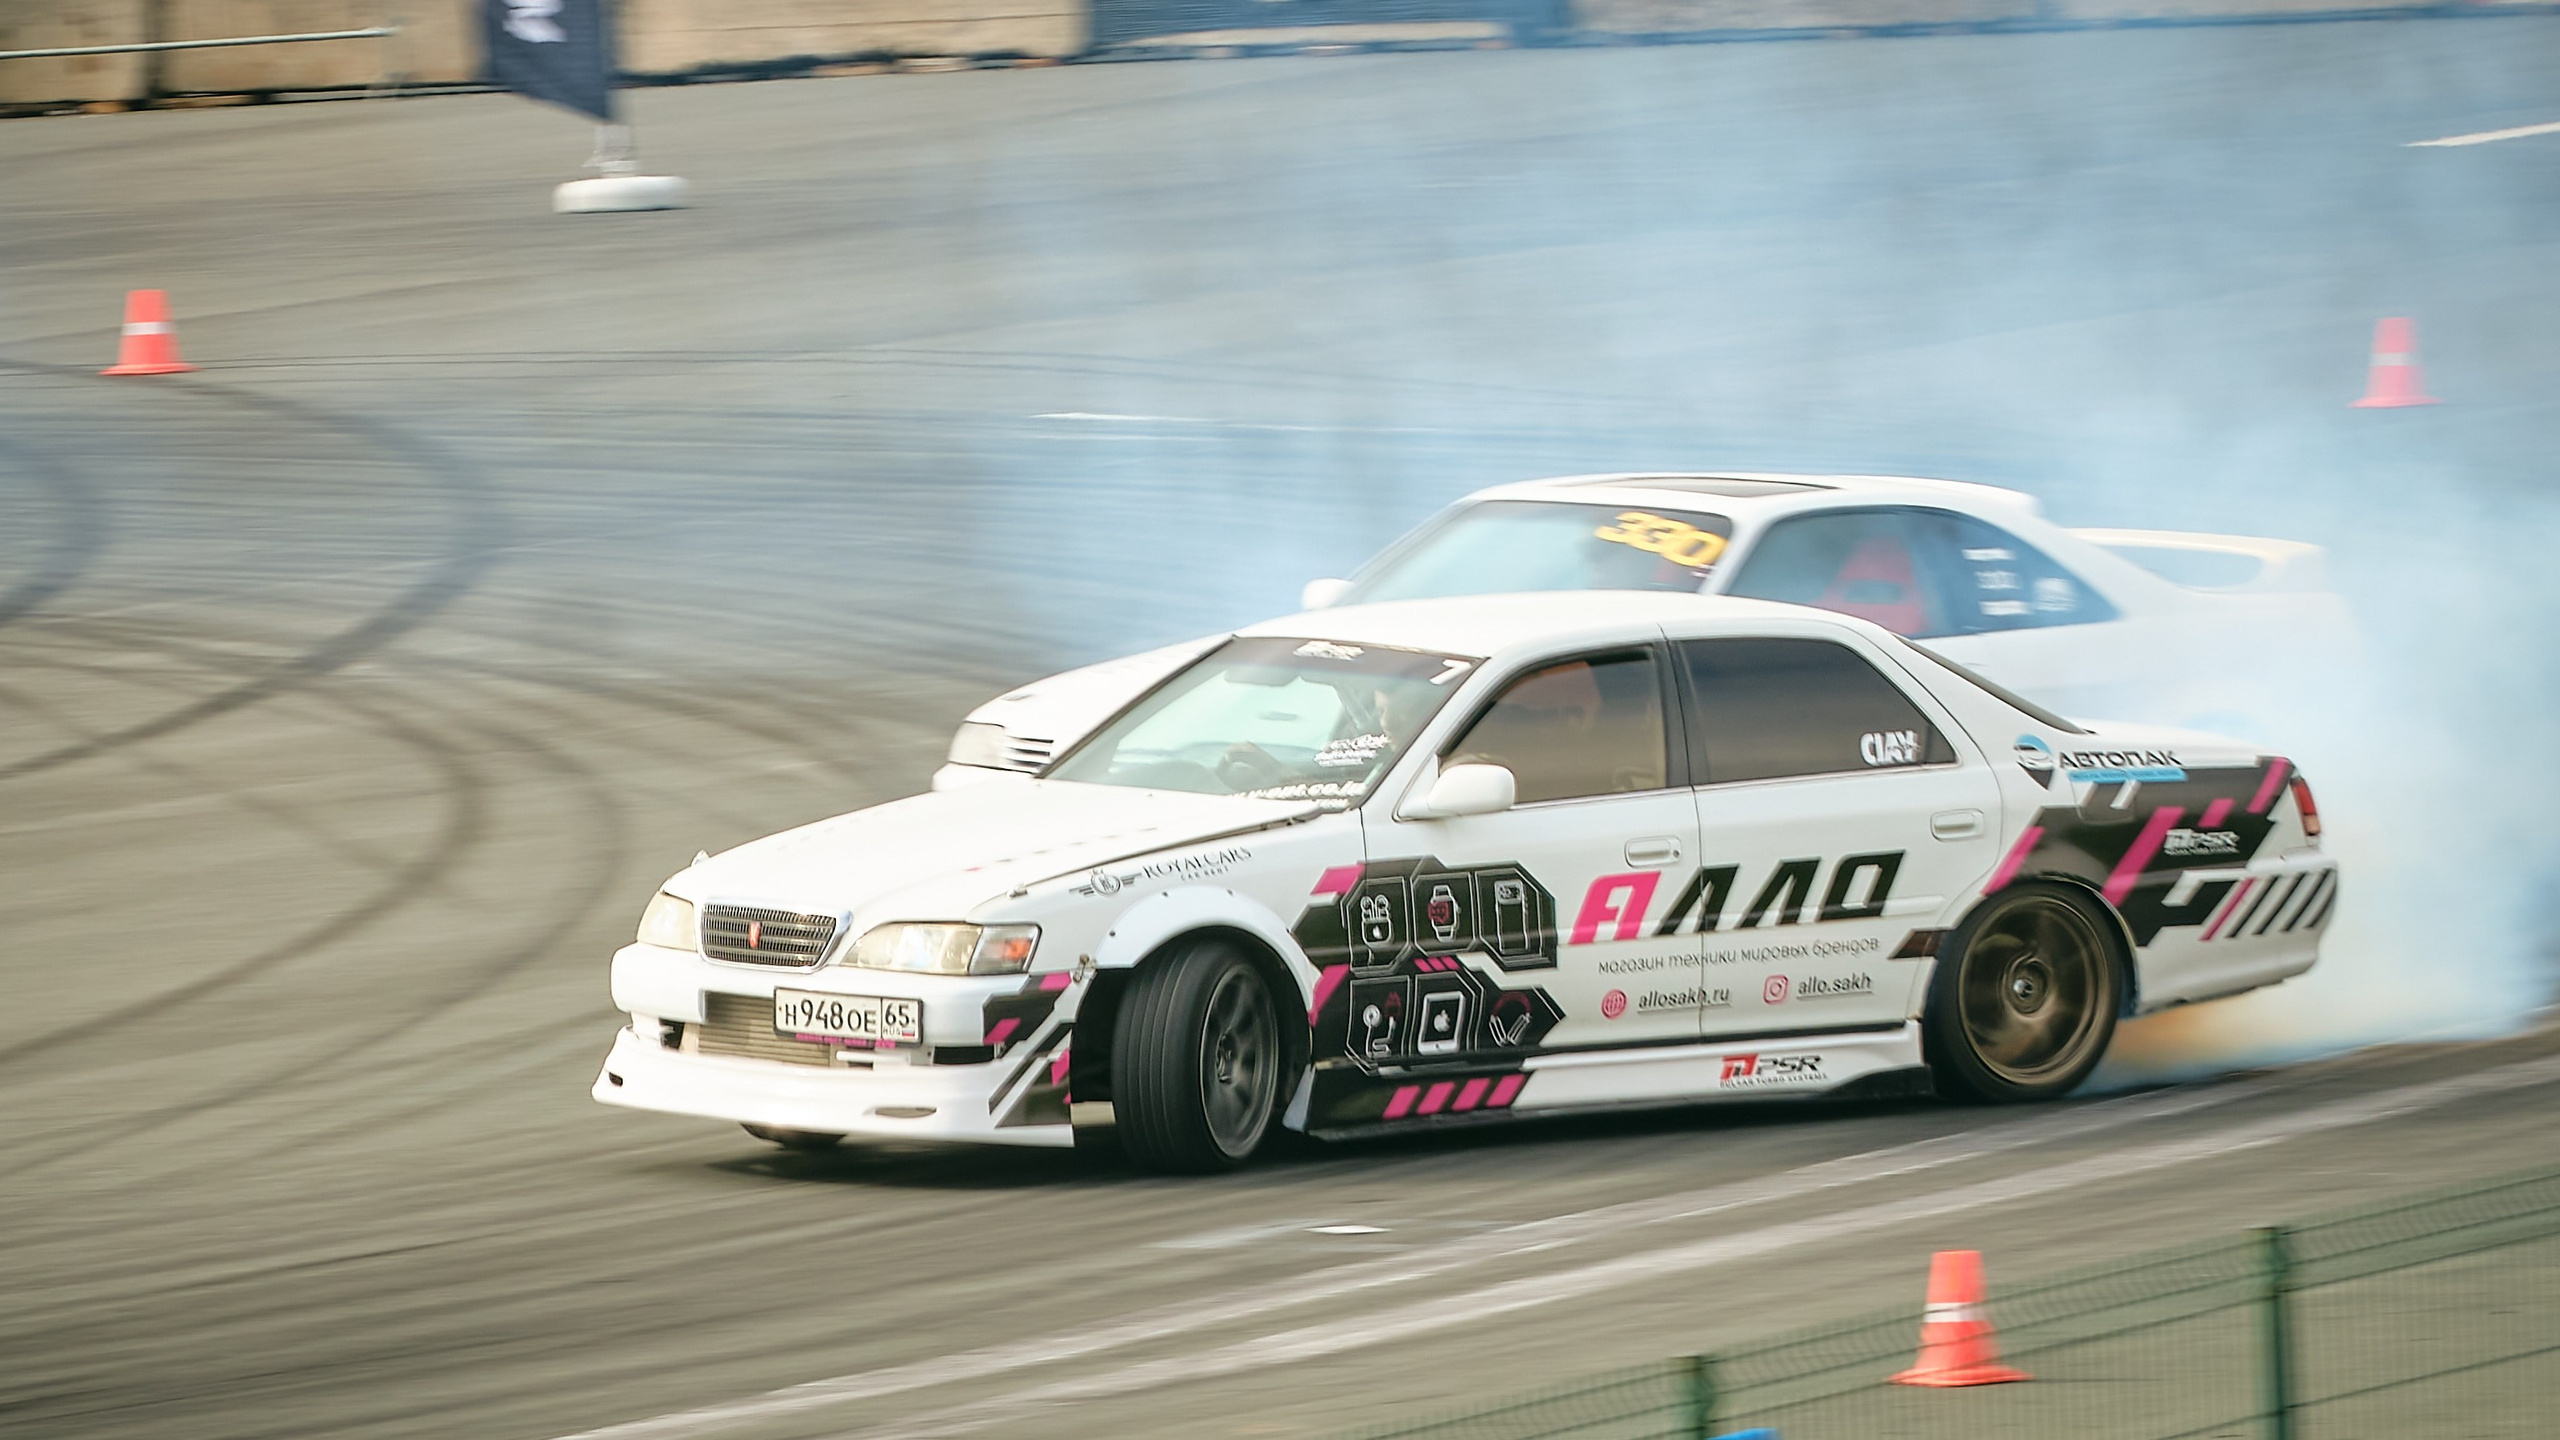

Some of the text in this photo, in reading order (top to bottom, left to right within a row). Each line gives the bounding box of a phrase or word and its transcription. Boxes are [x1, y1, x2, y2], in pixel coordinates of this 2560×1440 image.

[1593, 511, 1727, 567] 330
[2059, 750, 2182, 769] АВТОПАК
[1567, 849, 1906, 946] АЛЛО
[1598, 936, 1880, 975] магазин техники мировых брендов
[1797, 972, 1872, 995] allo.sakh
[1637, 986, 1731, 1009] allosakh.ru
[884, 1002, 910, 1028] 65
